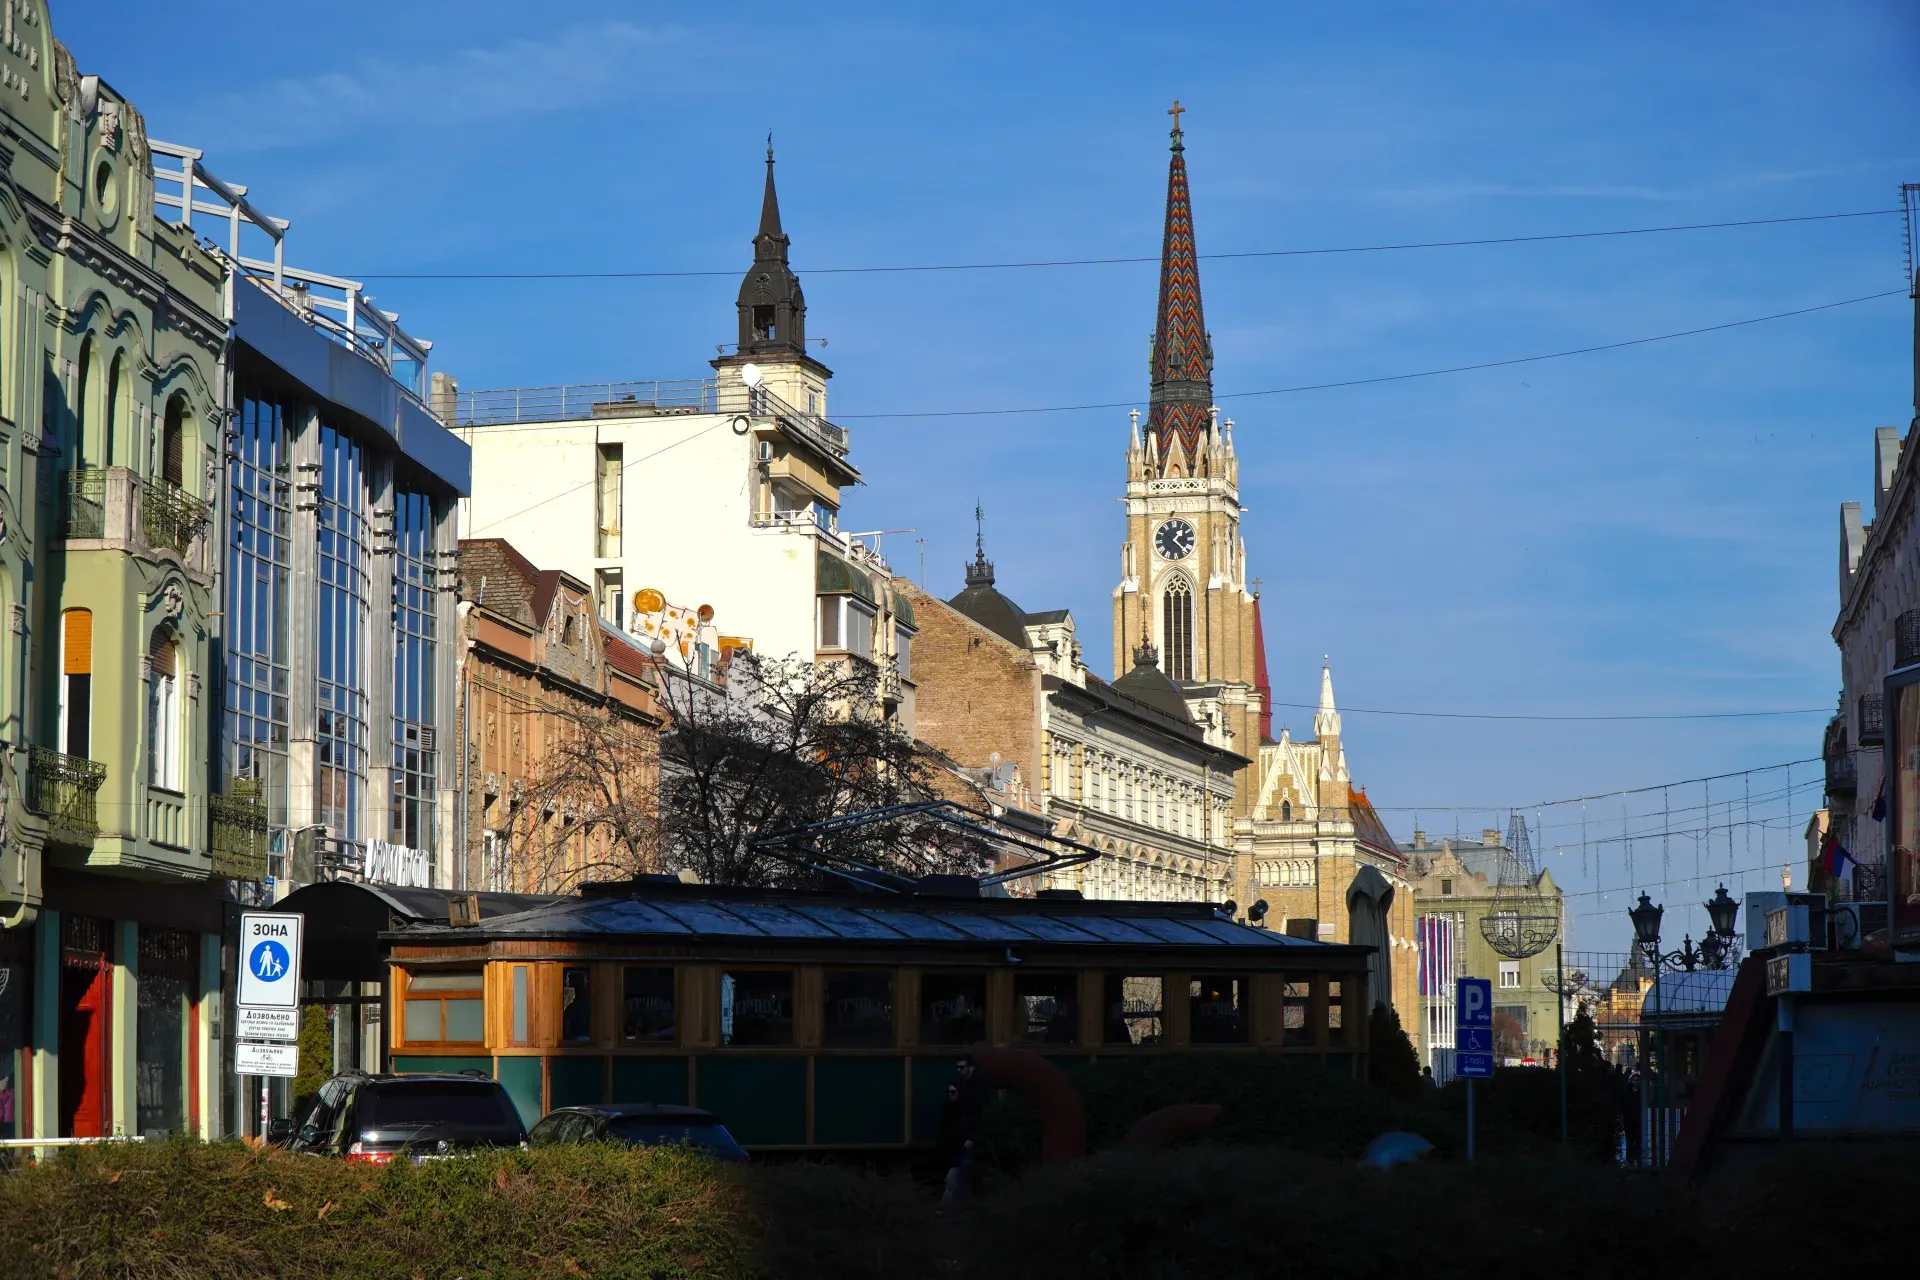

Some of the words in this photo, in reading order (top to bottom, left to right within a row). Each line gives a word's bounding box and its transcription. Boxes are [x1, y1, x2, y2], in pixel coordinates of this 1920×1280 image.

[253, 923, 288, 936] ЗОНА
[1465, 985, 1484, 1020] P
[246, 1010, 290, 1020] Дозвољено
[1464, 1055, 1468, 1064] 2
